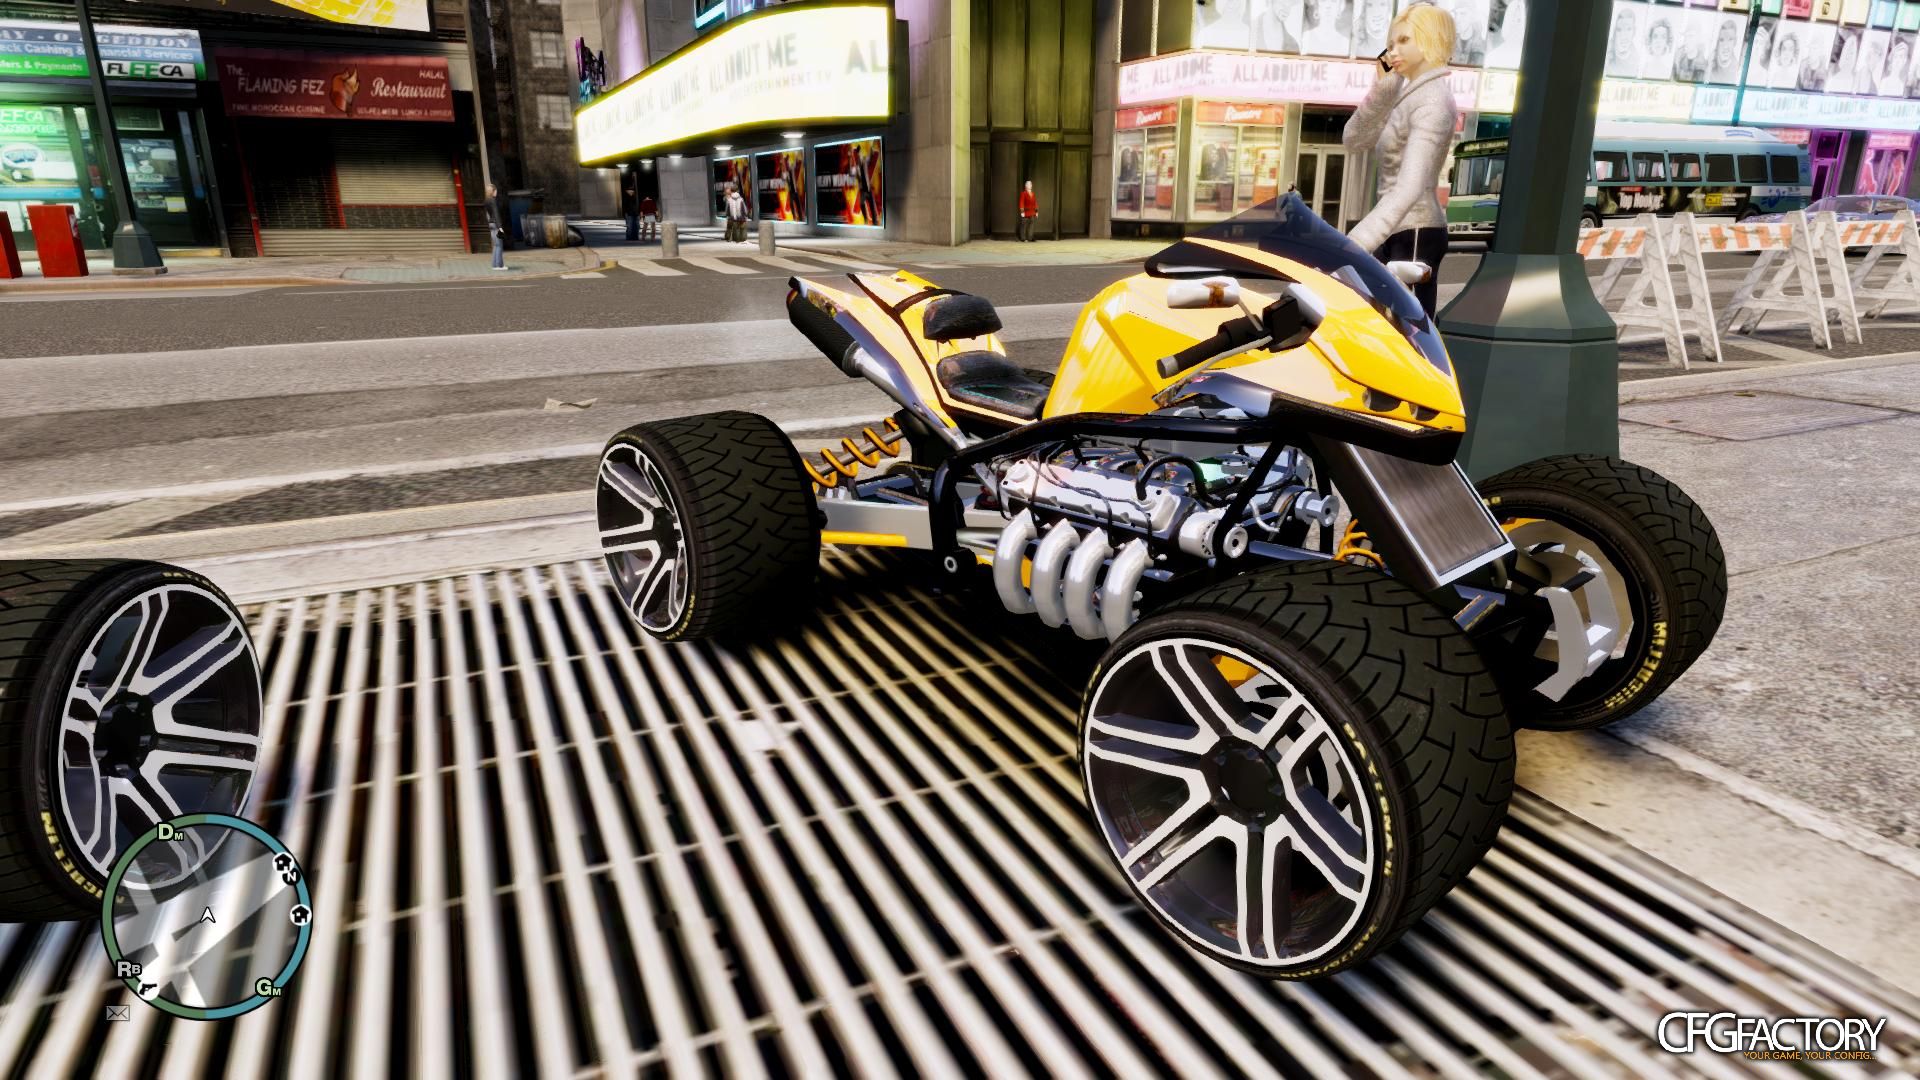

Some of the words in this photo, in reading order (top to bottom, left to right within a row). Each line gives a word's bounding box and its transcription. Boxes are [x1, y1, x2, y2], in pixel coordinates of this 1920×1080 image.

[97, 32, 190, 48] GEDDON
[24, 43, 73, 57] Cashing
[100, 48, 141, 58] nancial
[143, 49, 193, 60] Services
[767, 33, 798, 69] ME
[34, 61, 83, 71] Payments
[107, 62, 183, 77] FLEECA
[419, 70, 445, 79] HALAL
[1233, 63, 1258, 83] ALL
[1262, 63, 1306, 82] ABOUT
[1311, 63, 1328, 81] ME
[1345, 71, 1368, 88] ALL
[237, 77, 298, 94] FLAMING
[301, 79, 325, 96] FEZ
[370, 77, 447, 99] Restaurant
